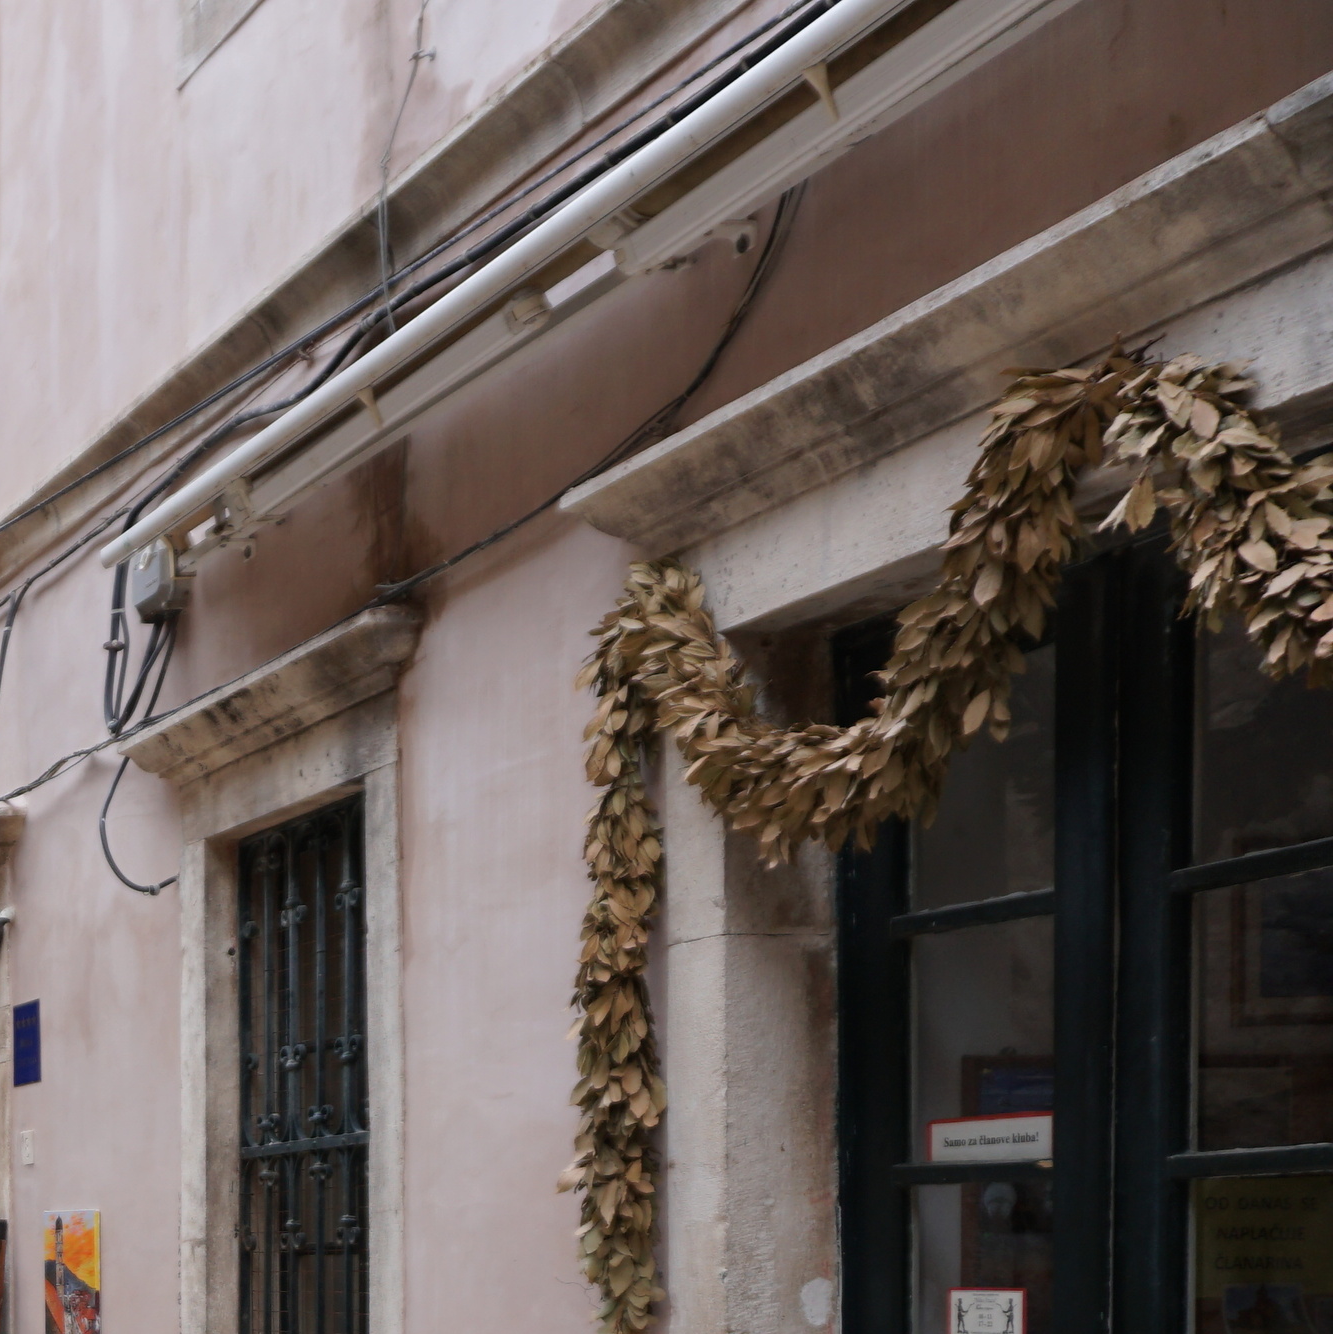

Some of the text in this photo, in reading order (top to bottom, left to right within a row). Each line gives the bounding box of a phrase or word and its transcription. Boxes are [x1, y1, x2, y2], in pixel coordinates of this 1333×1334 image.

[943, 1137, 966, 1147] Samo
[979, 1135, 1010, 1145] članove
[1012, 1132, 1039, 1143] kluba!
